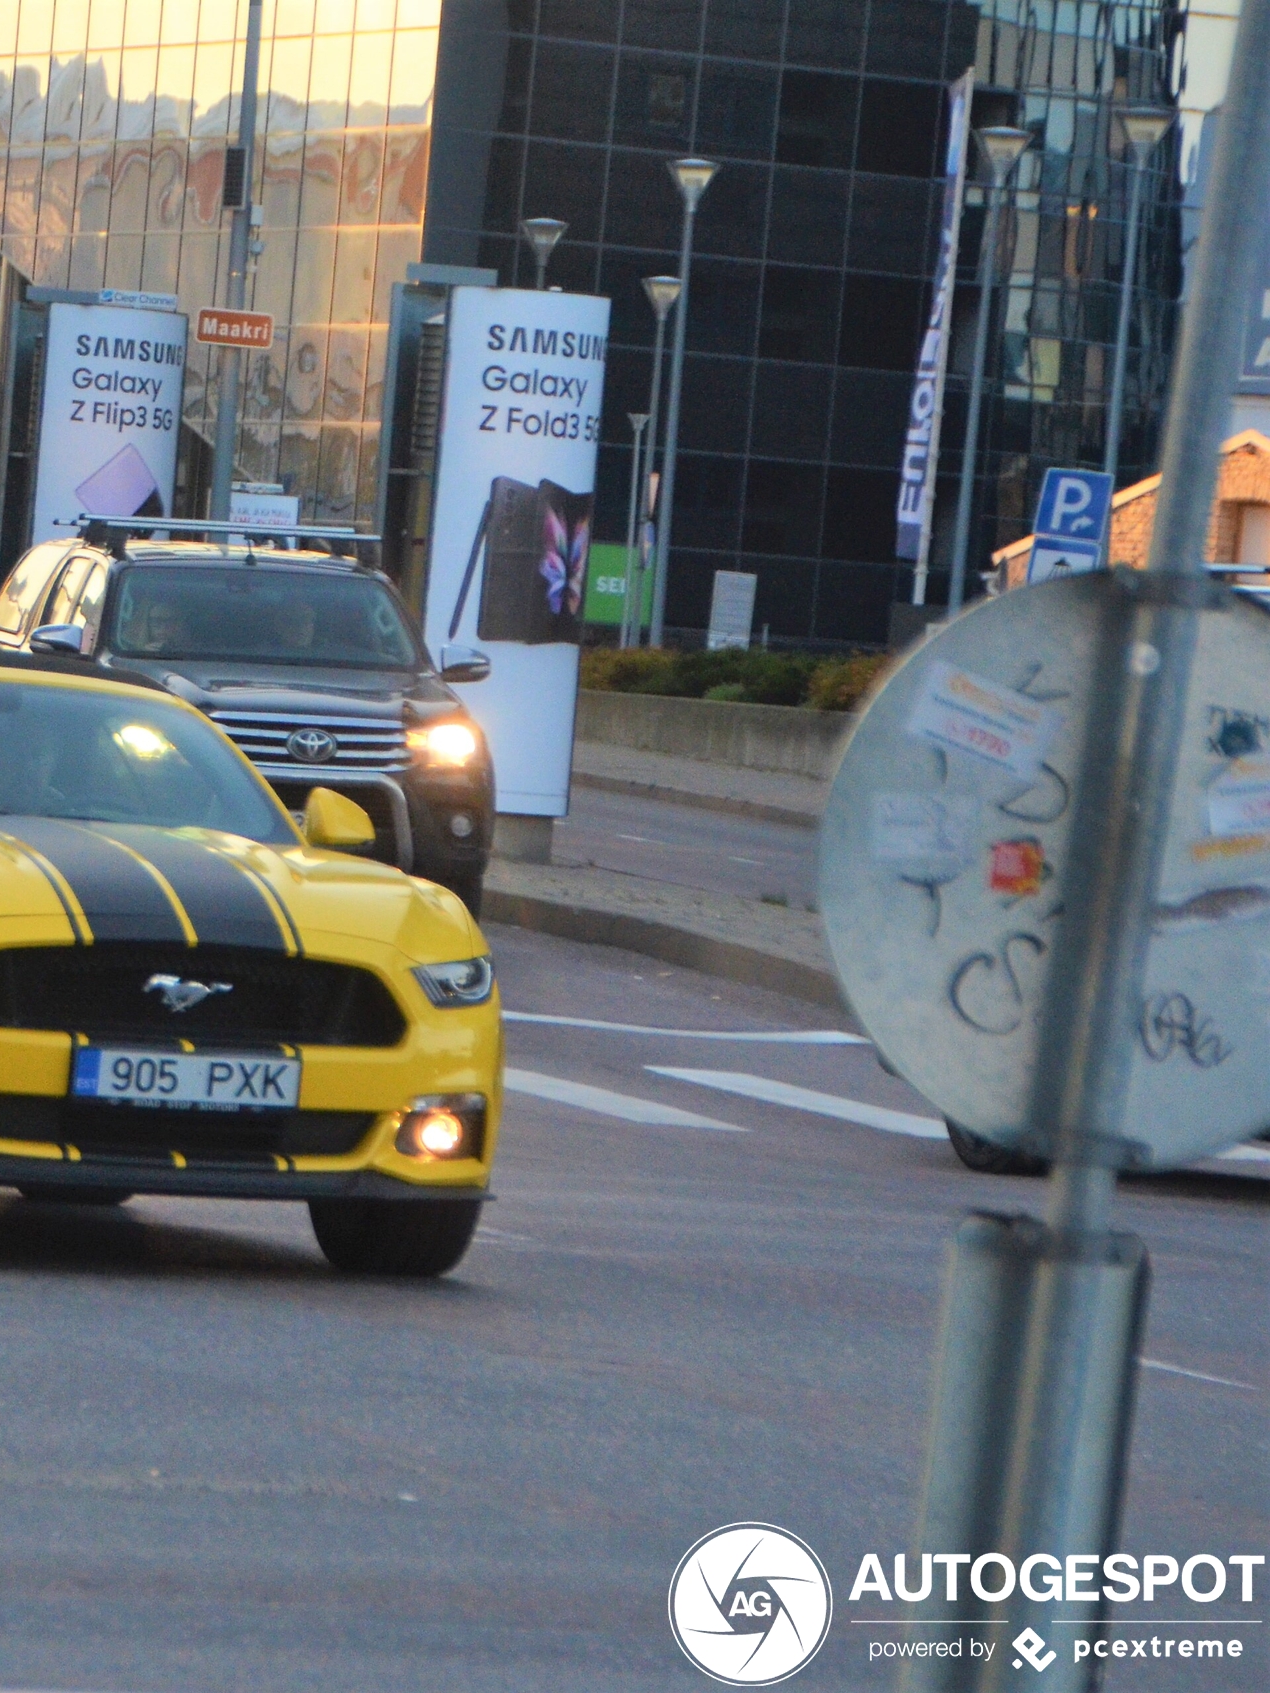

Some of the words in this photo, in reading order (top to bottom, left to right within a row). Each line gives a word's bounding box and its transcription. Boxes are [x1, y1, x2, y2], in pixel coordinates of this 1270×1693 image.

[203, 317, 268, 340] Maakri
[487, 324, 606, 361] SAMSUN
[72, 367, 162, 402] Galaxy
[482, 365, 588, 407] Galaxy
[70, 400, 85, 421] Z
[92, 401, 147, 432] Flip3
[152, 407, 173, 431] 5G
[479, 404, 497, 431] Z
[507, 407, 580, 440] Fold3
[1051, 477, 1092, 531] P
[112, 1057, 179, 1093] 905
[207, 1061, 289, 1099] PXK
